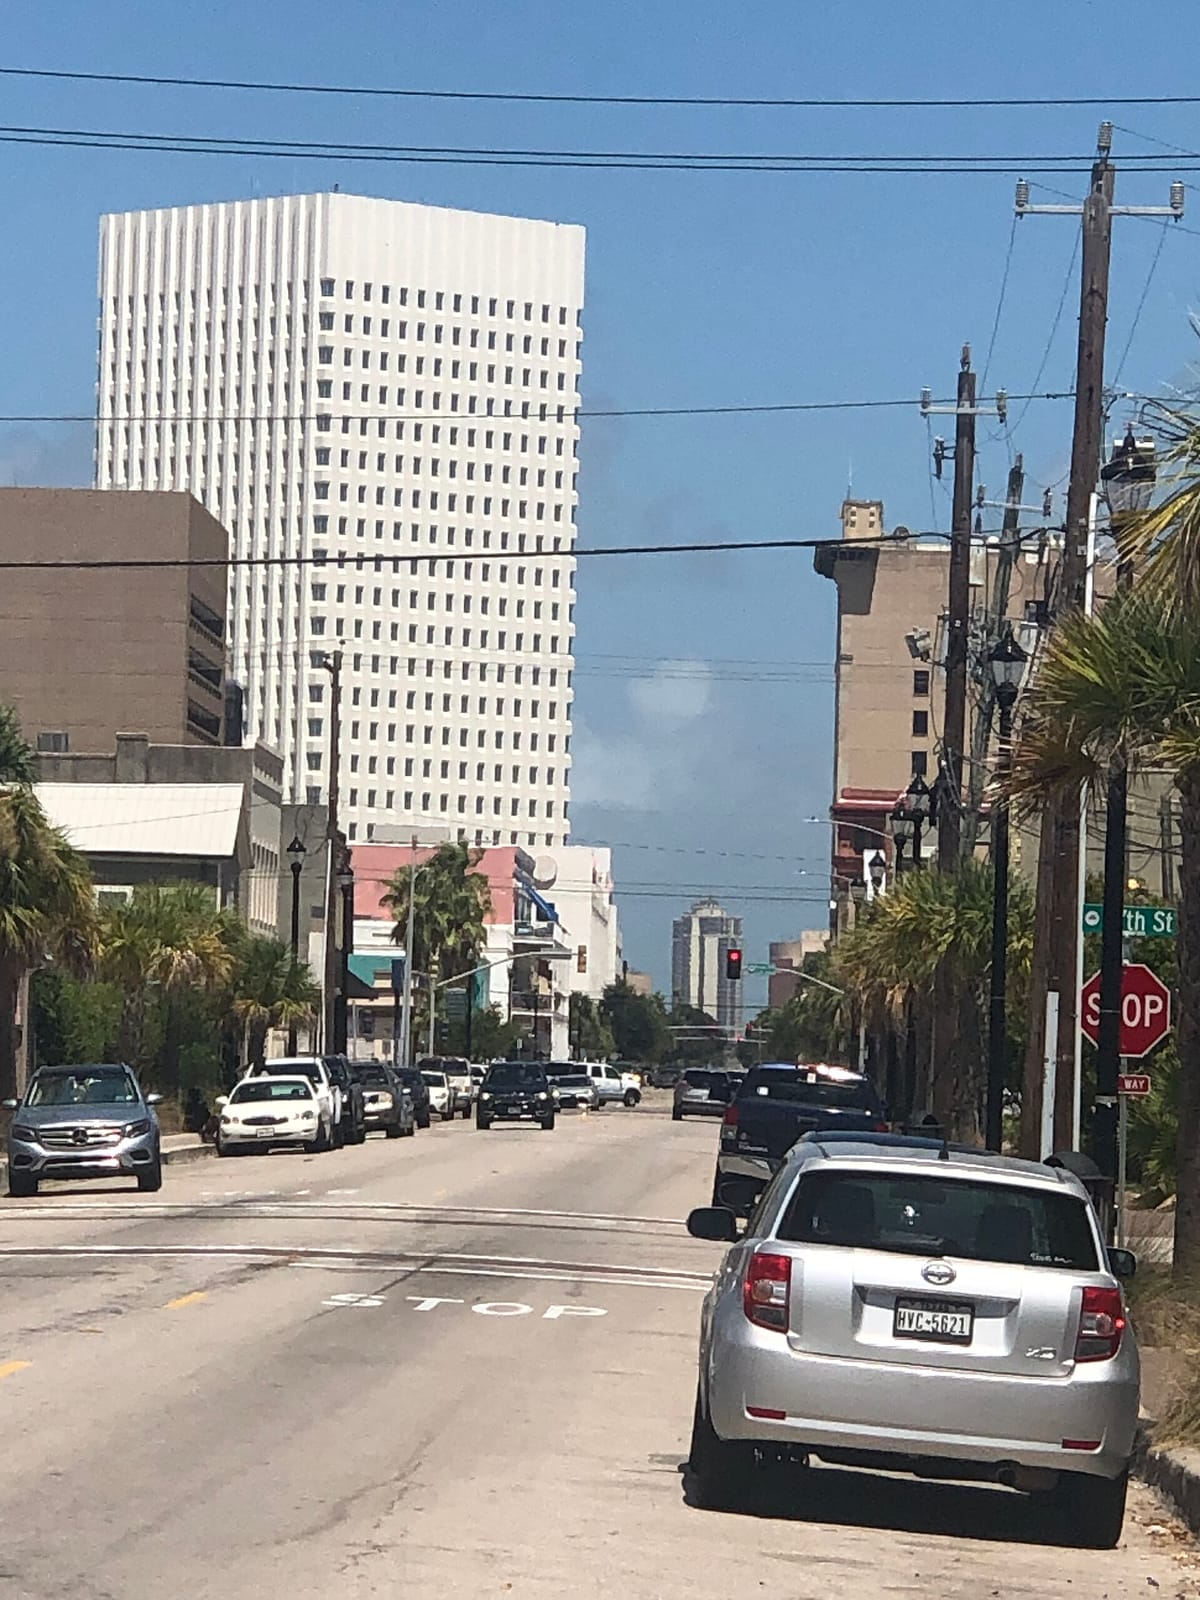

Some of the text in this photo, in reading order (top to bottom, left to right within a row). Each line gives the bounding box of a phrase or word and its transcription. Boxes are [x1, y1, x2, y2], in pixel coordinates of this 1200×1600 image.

[1122, 909, 1174, 933] th St
[1085, 992, 1164, 1028] SOP
[1123, 1079, 1145, 1090] WAY
[319, 1292, 609, 1320] STOP
